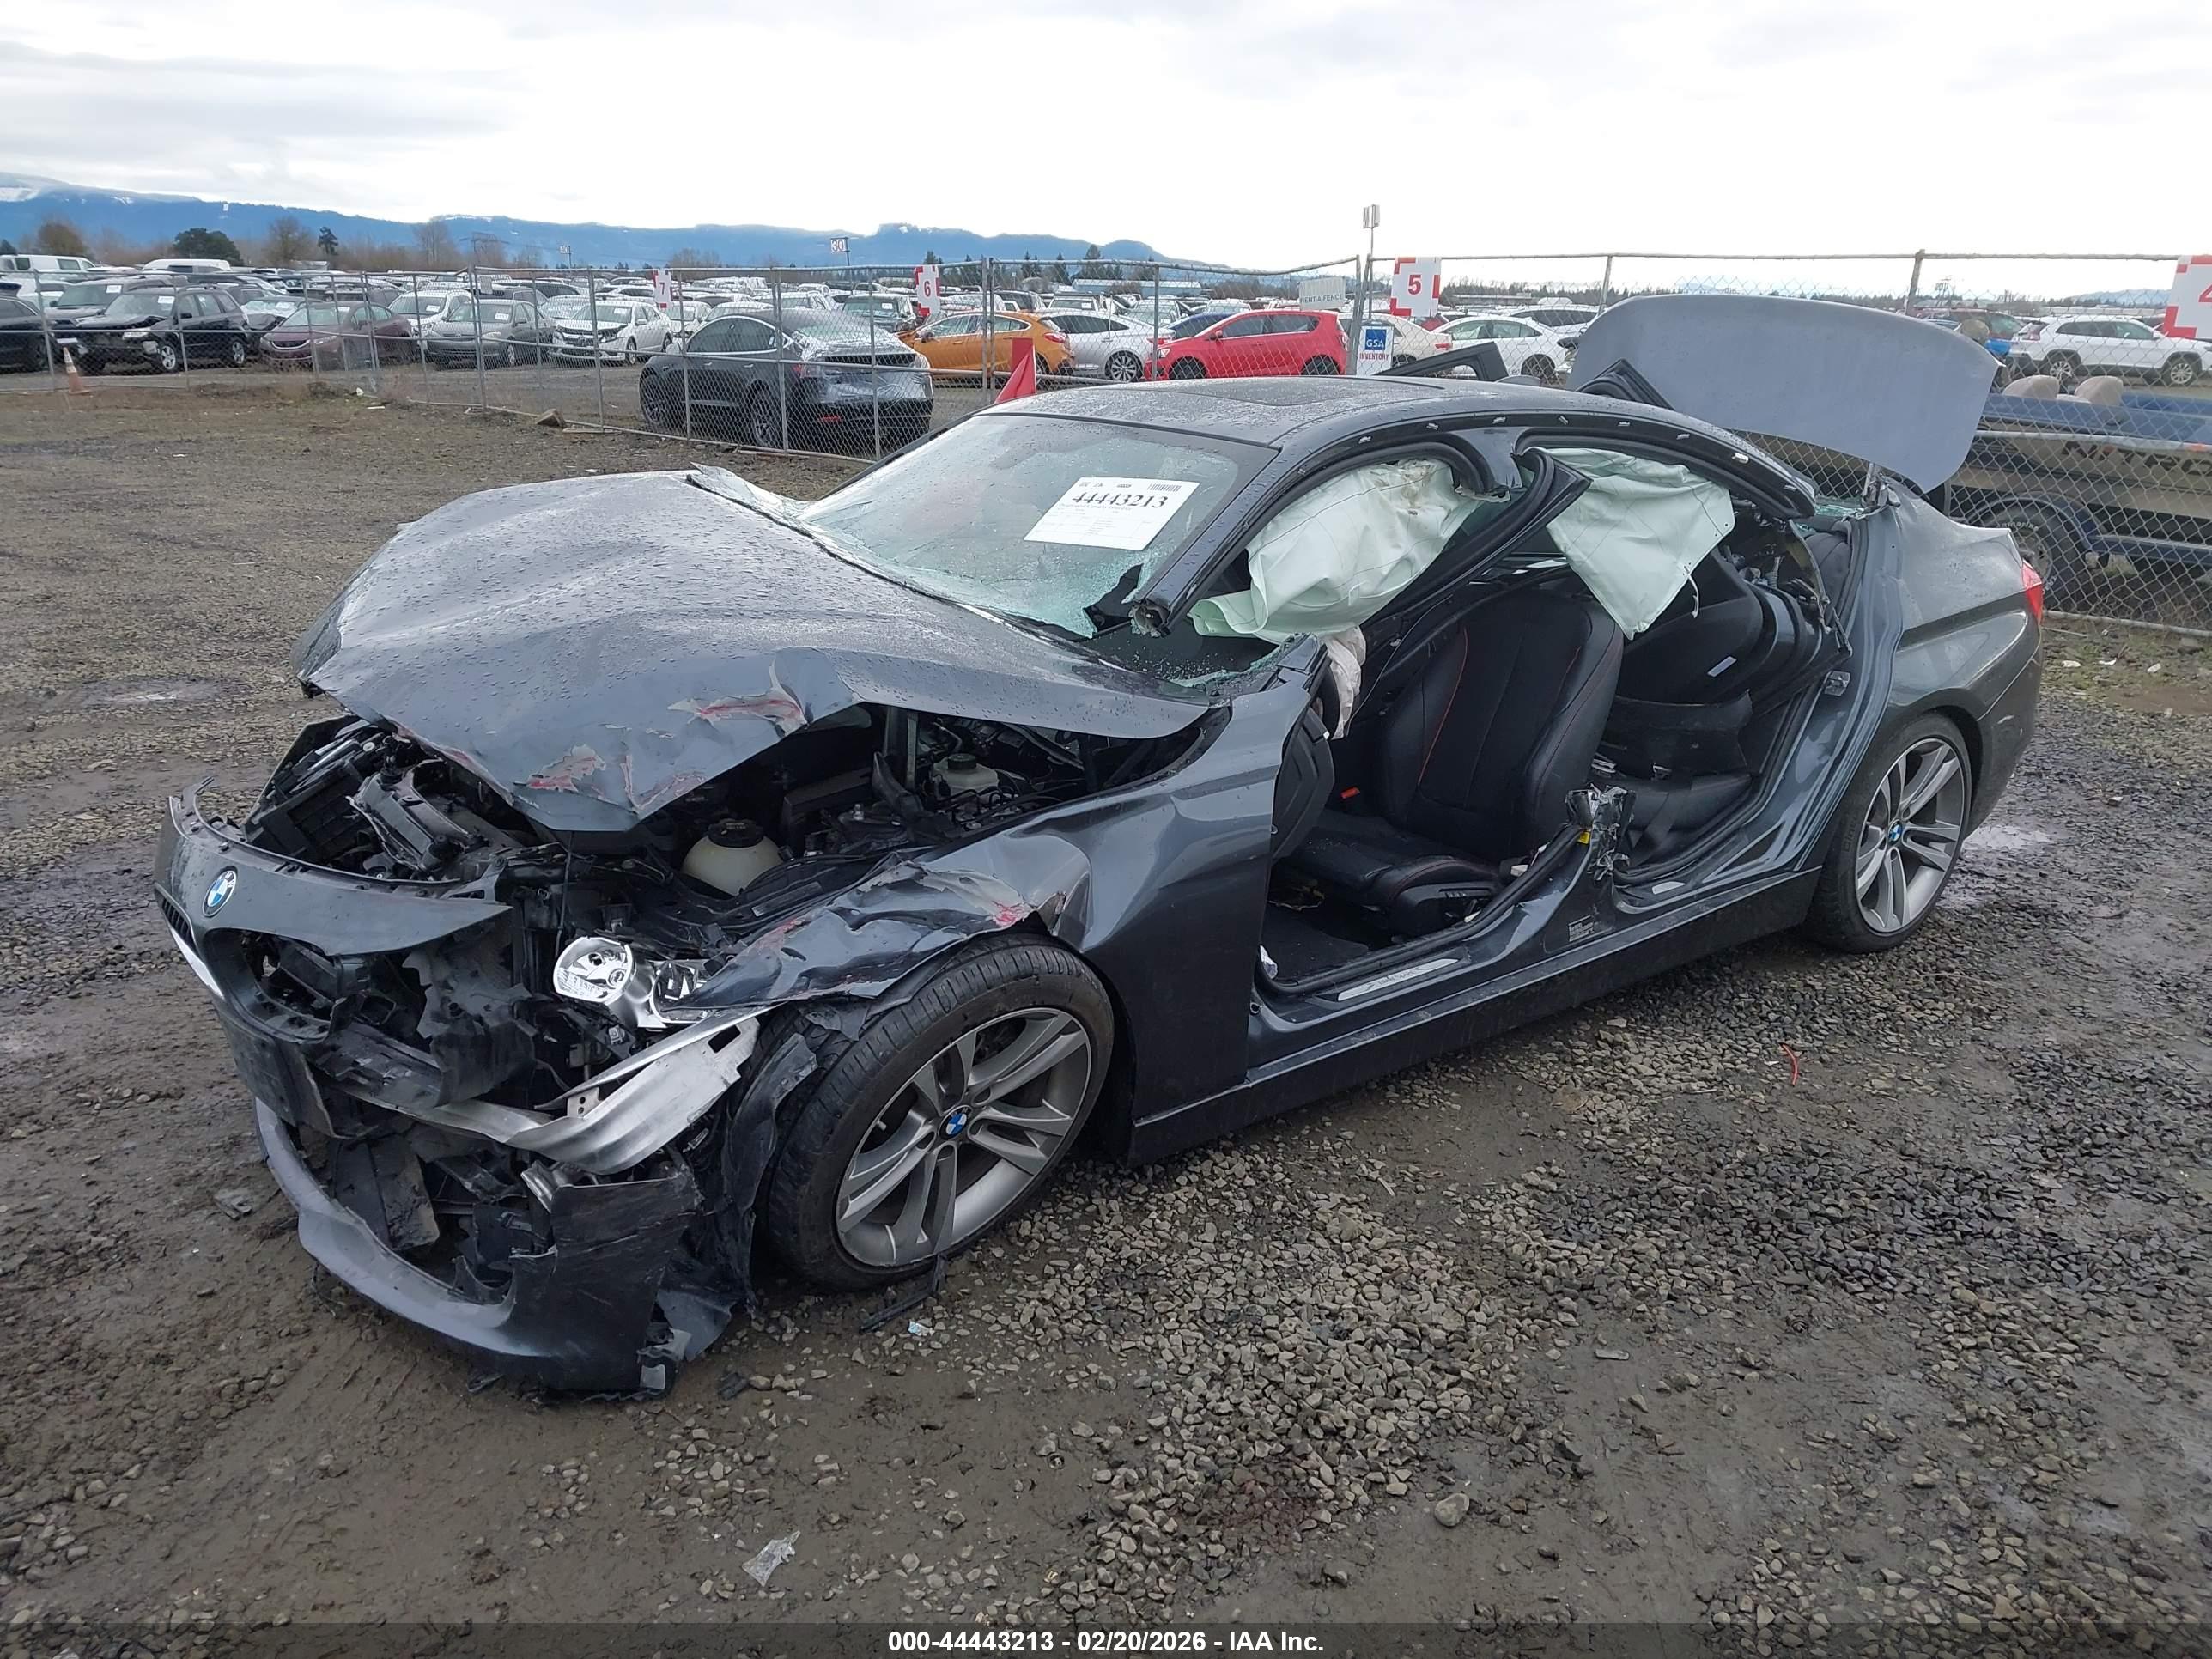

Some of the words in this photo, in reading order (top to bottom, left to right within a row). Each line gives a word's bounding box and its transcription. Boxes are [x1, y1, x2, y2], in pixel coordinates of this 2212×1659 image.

[831, 240, 844, 252] 30
[659, 282, 665, 295] 7
[923, 280, 932, 297] 6
[1407, 274, 1422, 295] 5
[1366, 339, 1385, 348] GSA
[1359, 353, 1389, 362] INVENTORY
[1072, 492, 1169, 508] 44443213
